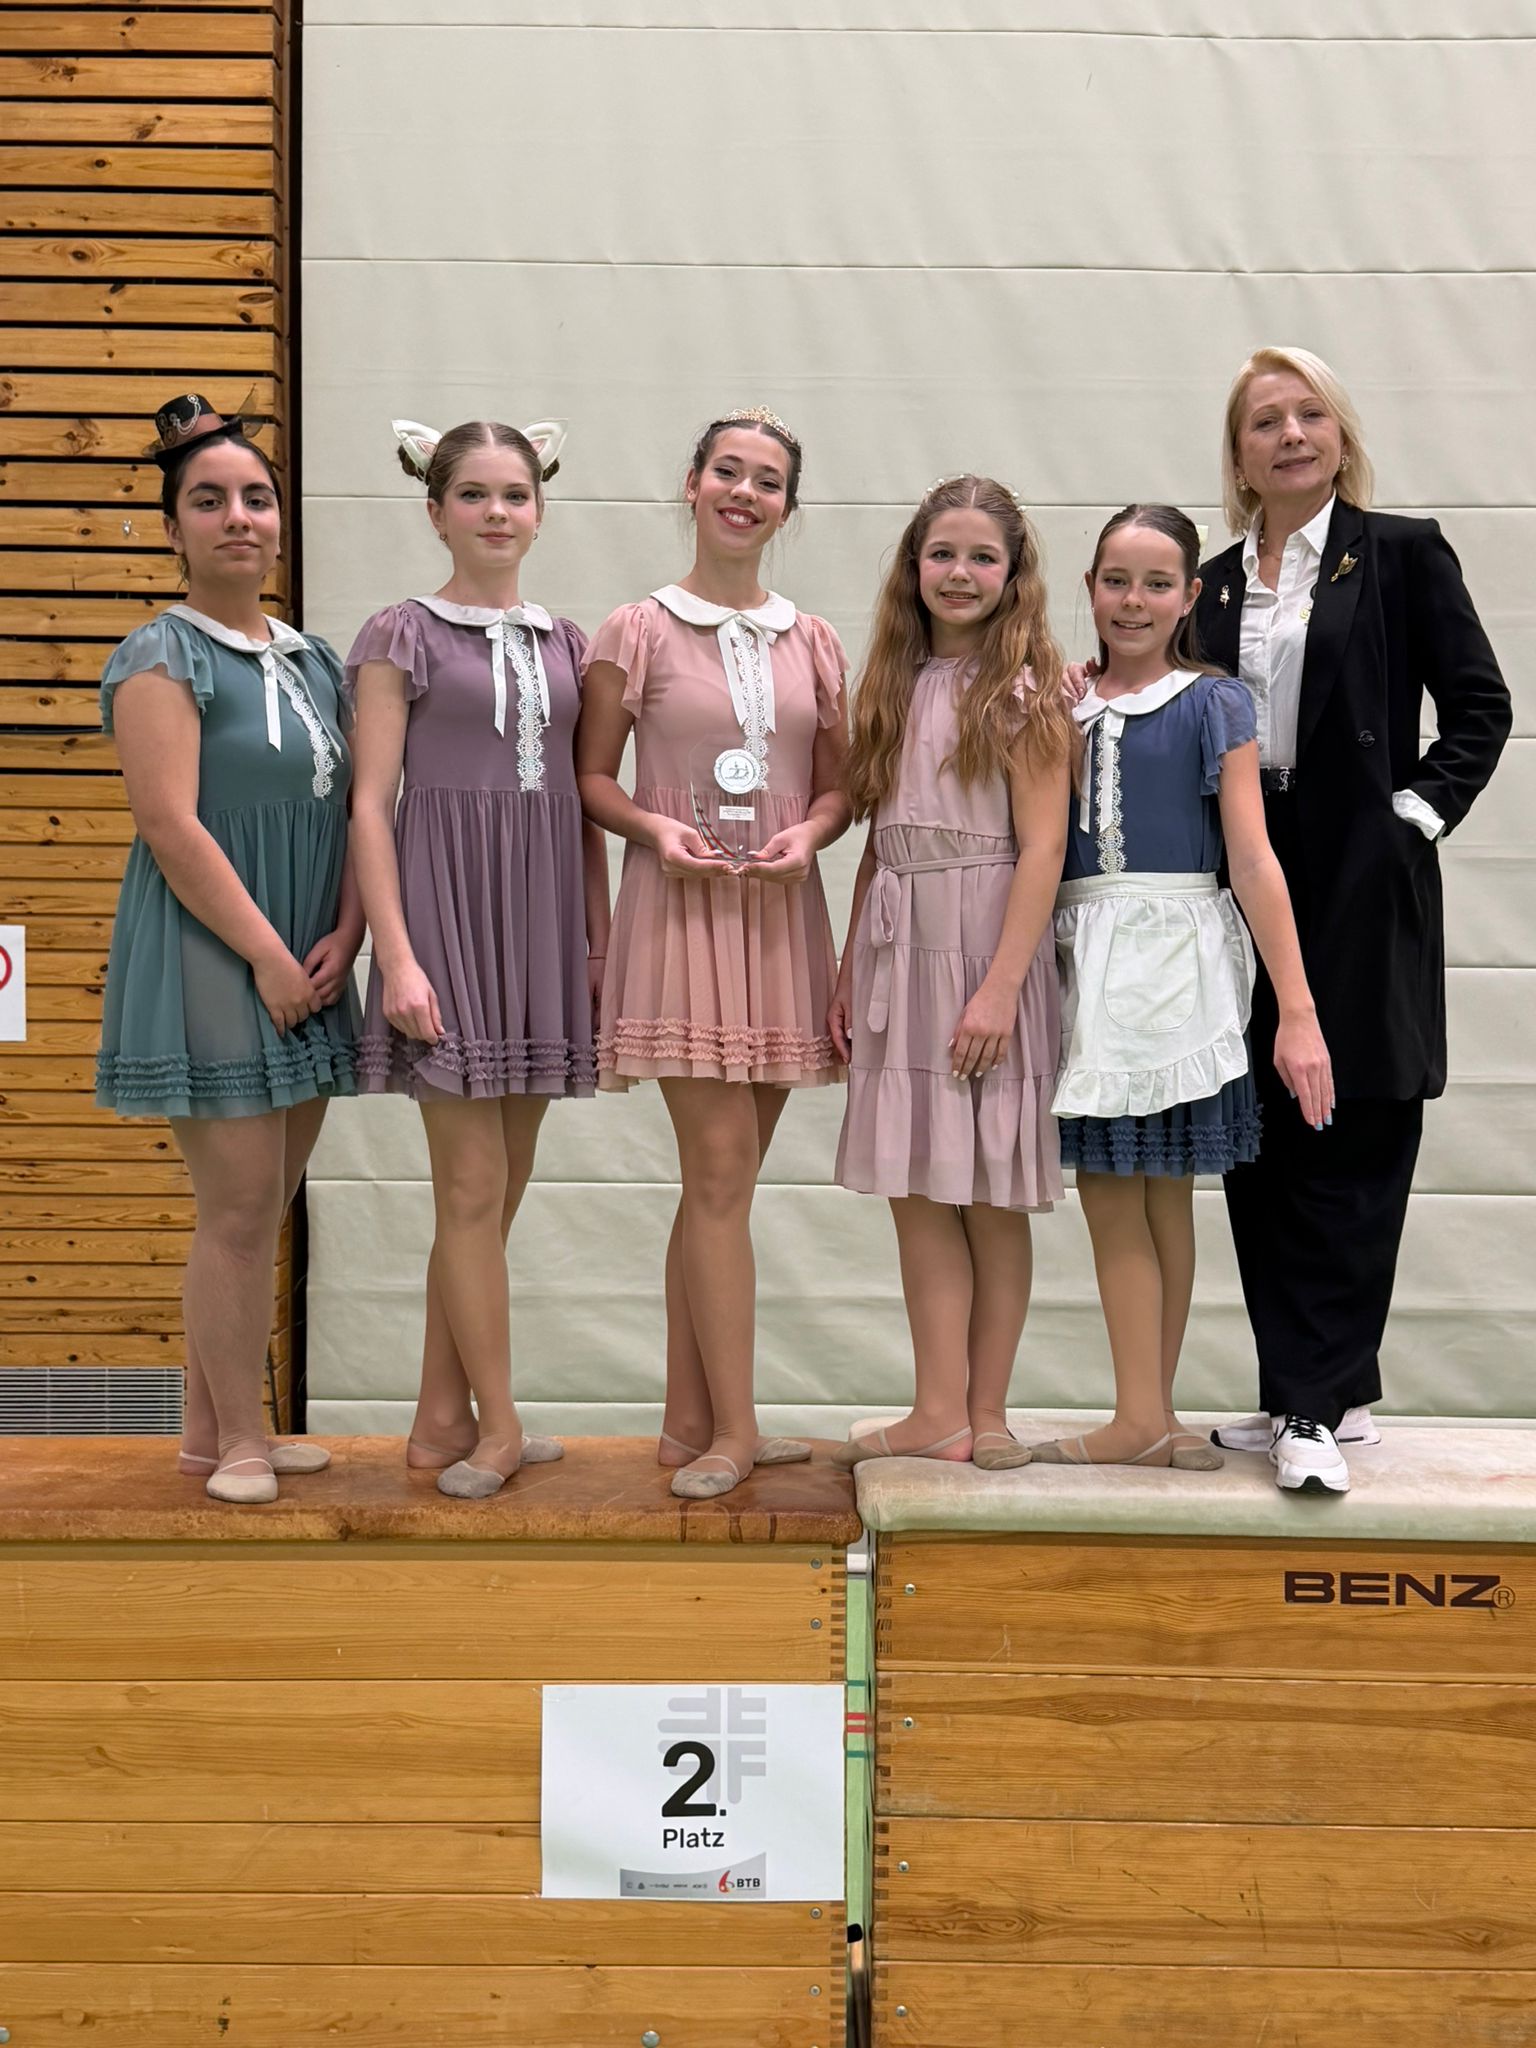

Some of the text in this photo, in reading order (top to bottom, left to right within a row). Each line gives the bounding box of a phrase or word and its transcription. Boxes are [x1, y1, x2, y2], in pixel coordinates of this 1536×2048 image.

[661, 1740, 727, 1818] 2.
[662, 1827, 725, 1849] Platz
[736, 1878, 761, 1888] BTB
